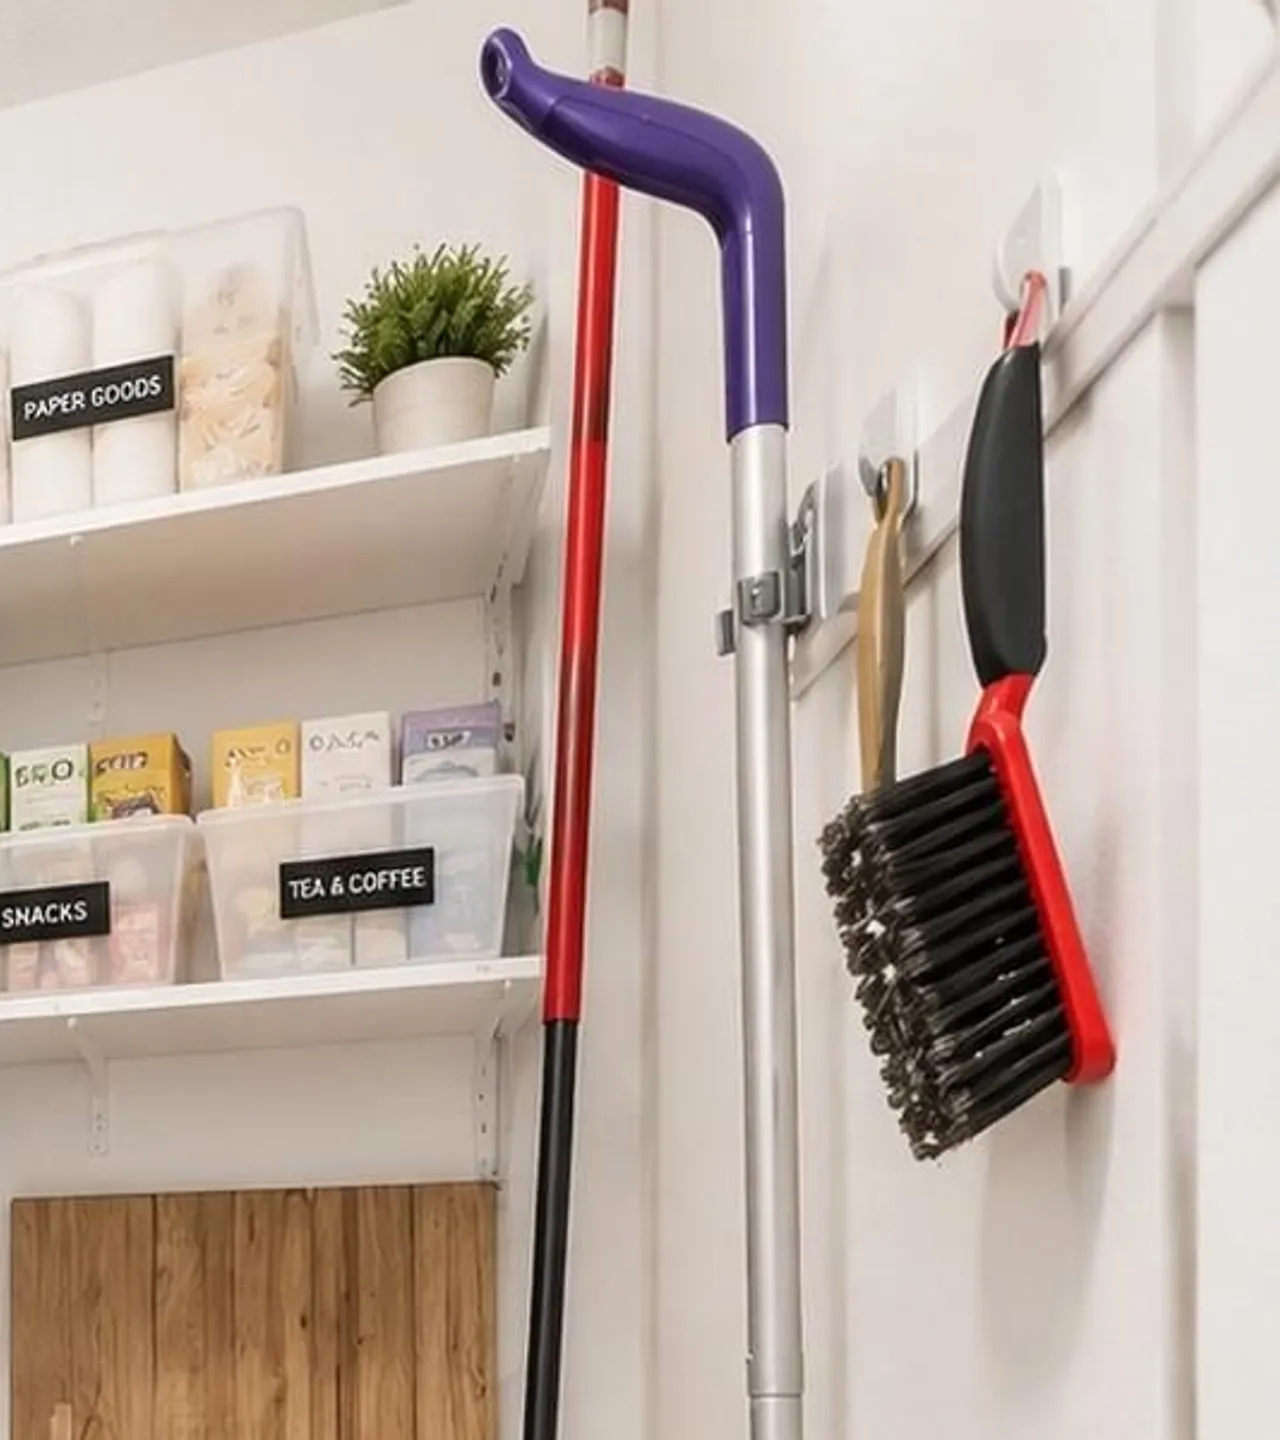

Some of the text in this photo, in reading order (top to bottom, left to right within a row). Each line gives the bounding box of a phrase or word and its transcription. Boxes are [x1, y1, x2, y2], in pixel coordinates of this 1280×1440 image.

[23, 375, 162, 421] PAPER GOODS
[289, 866, 427, 899] TEA & COFFEE
[1, 900, 88, 929] SNACKS
